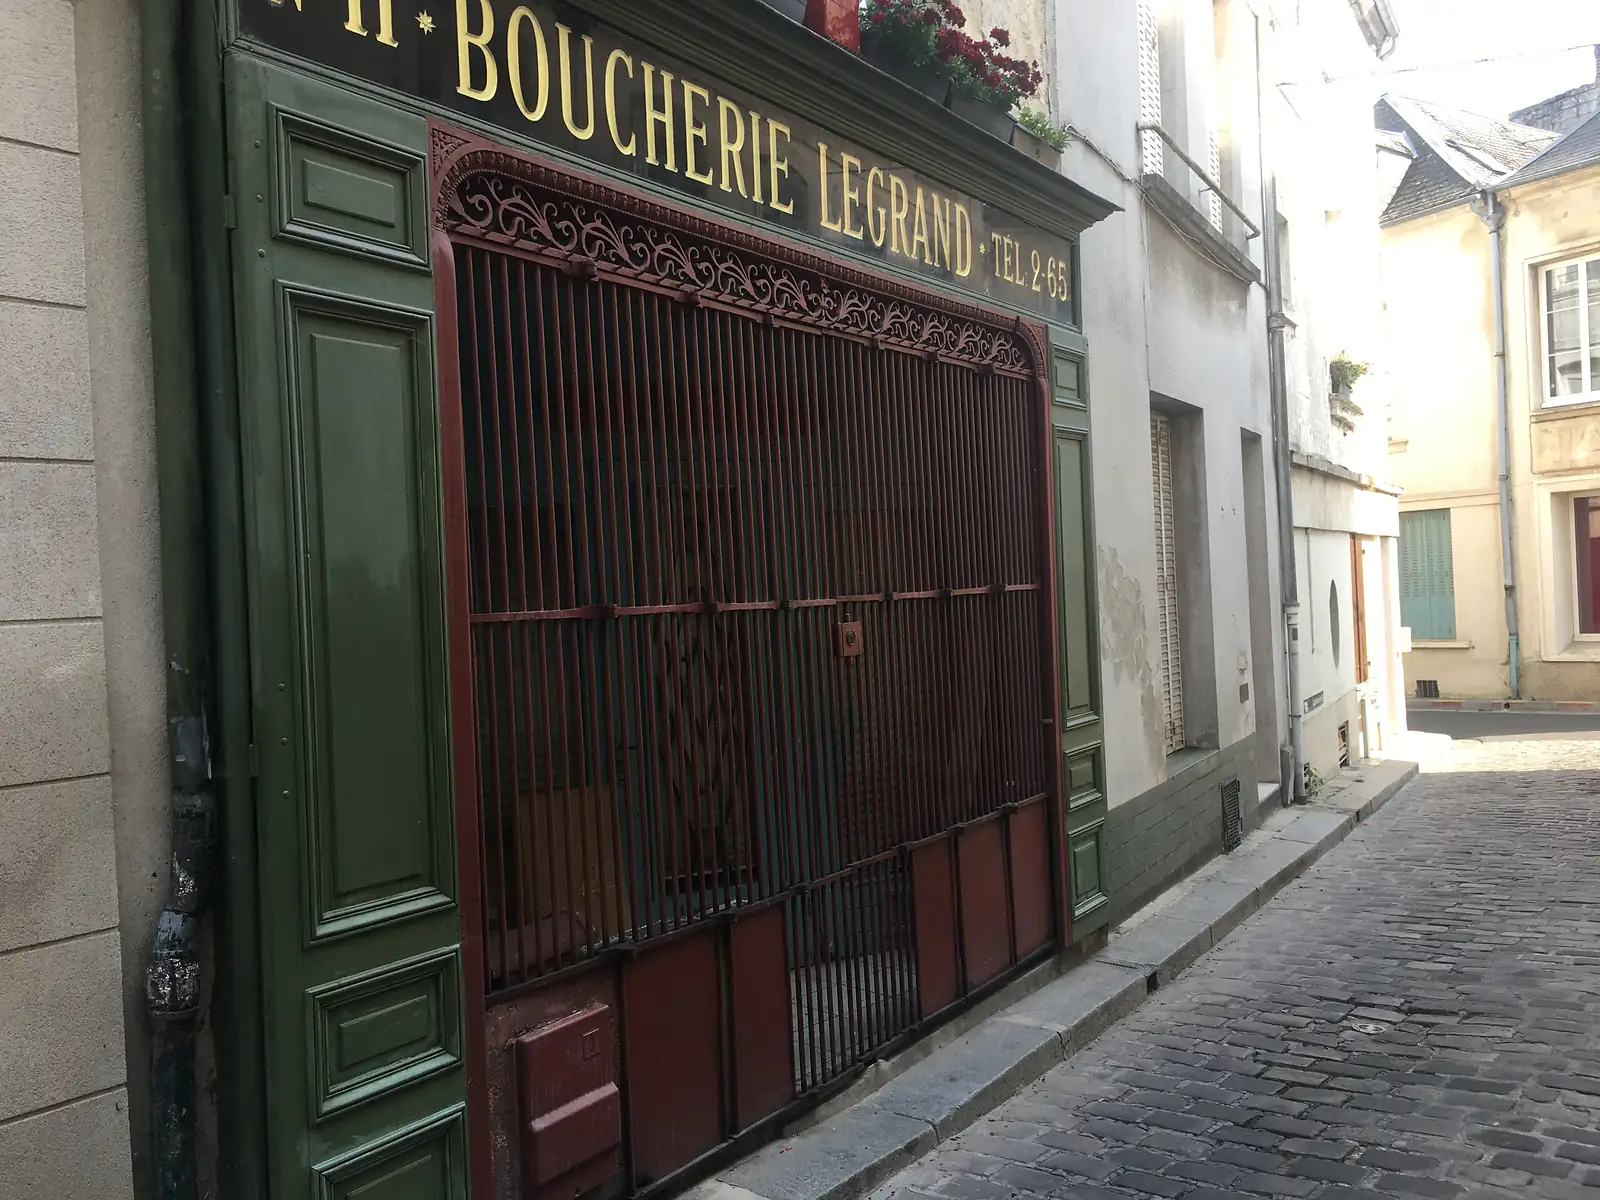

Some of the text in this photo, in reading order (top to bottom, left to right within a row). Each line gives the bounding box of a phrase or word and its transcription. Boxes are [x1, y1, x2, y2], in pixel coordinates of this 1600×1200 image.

[456, 0, 794, 214] BOUCHERIE
[817, 142, 973, 277] LEGRAND
[1031, 249, 1067, 301] 2-65
